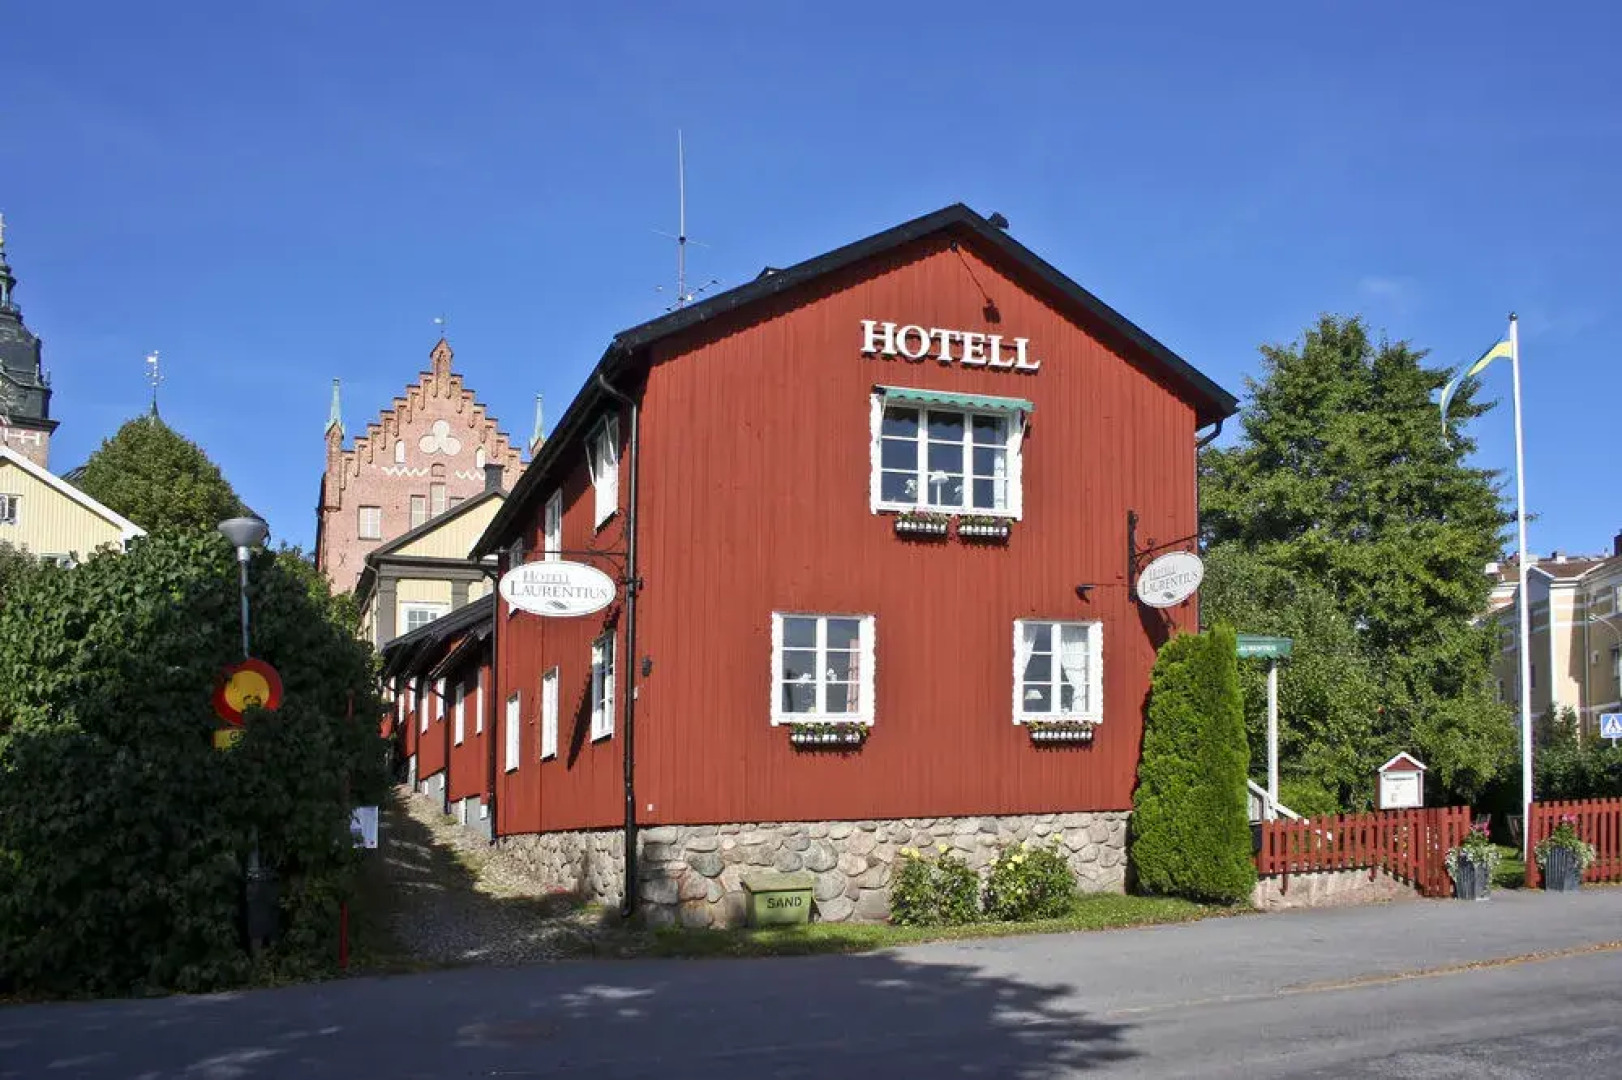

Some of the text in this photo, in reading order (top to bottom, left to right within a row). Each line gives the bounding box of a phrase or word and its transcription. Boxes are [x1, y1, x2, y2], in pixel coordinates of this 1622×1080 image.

[860, 320, 1041, 370] HOTELL
[510, 580, 608, 599] LAURENTIUS
[766, 896, 802, 909] SAND
